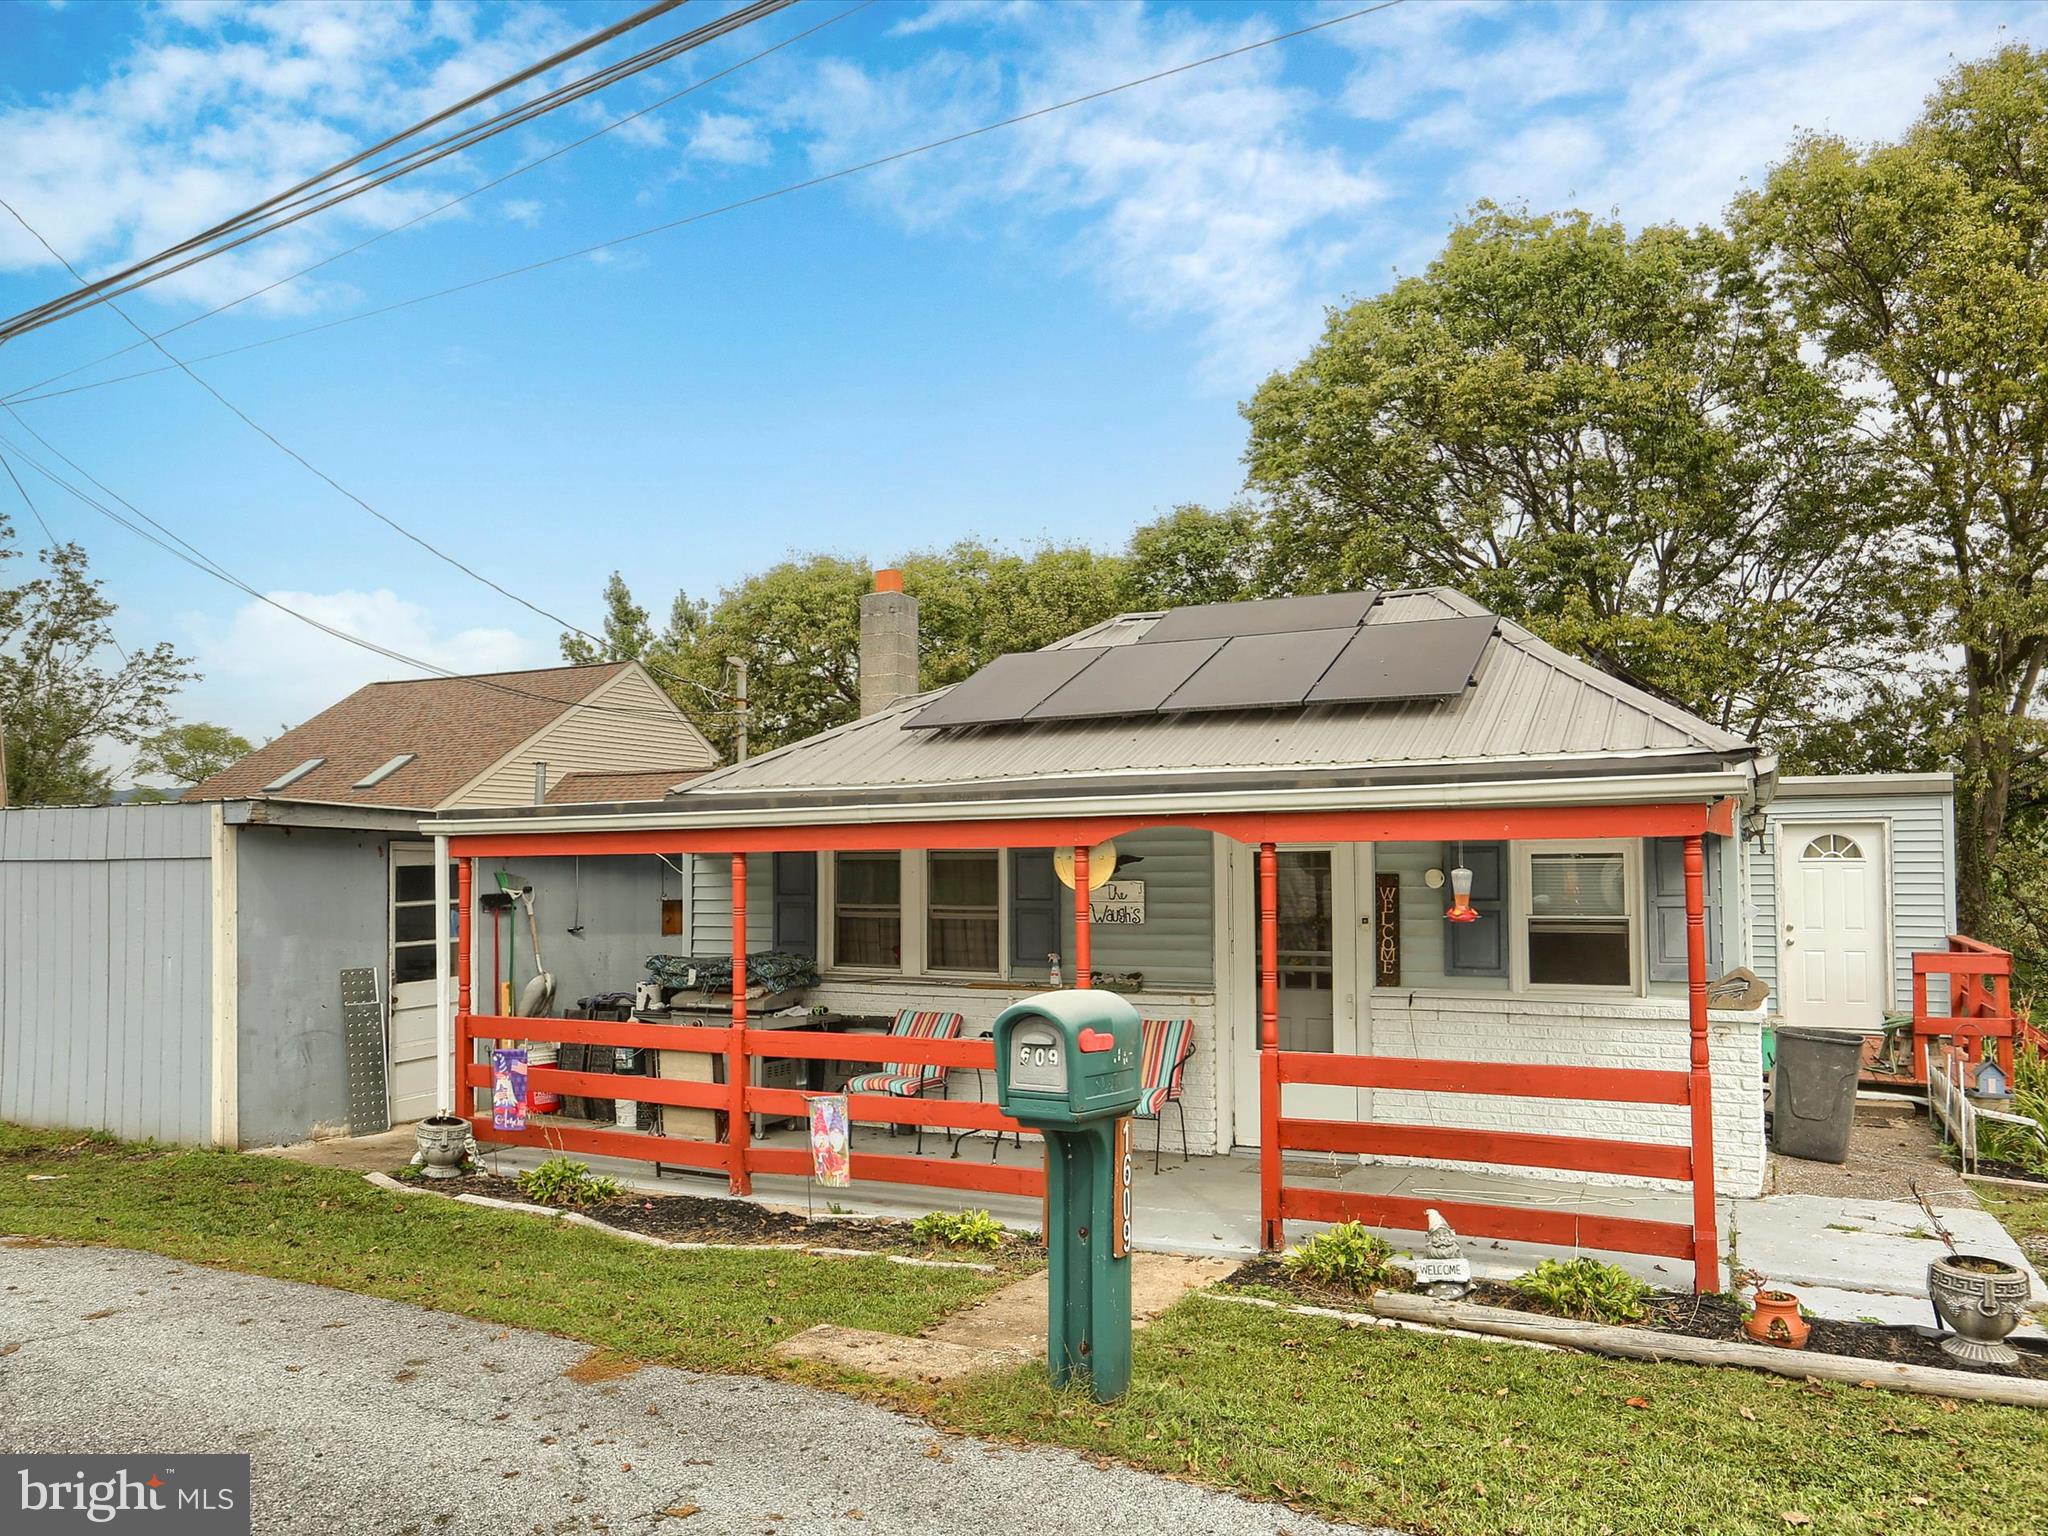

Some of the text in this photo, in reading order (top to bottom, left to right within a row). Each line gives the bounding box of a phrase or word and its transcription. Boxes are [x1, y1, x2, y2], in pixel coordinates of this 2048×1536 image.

[1379, 887, 1396, 974] WELCOME
[1122, 1120, 1132, 1253] 1609
[1420, 1264, 1461, 1276] WELCOME
